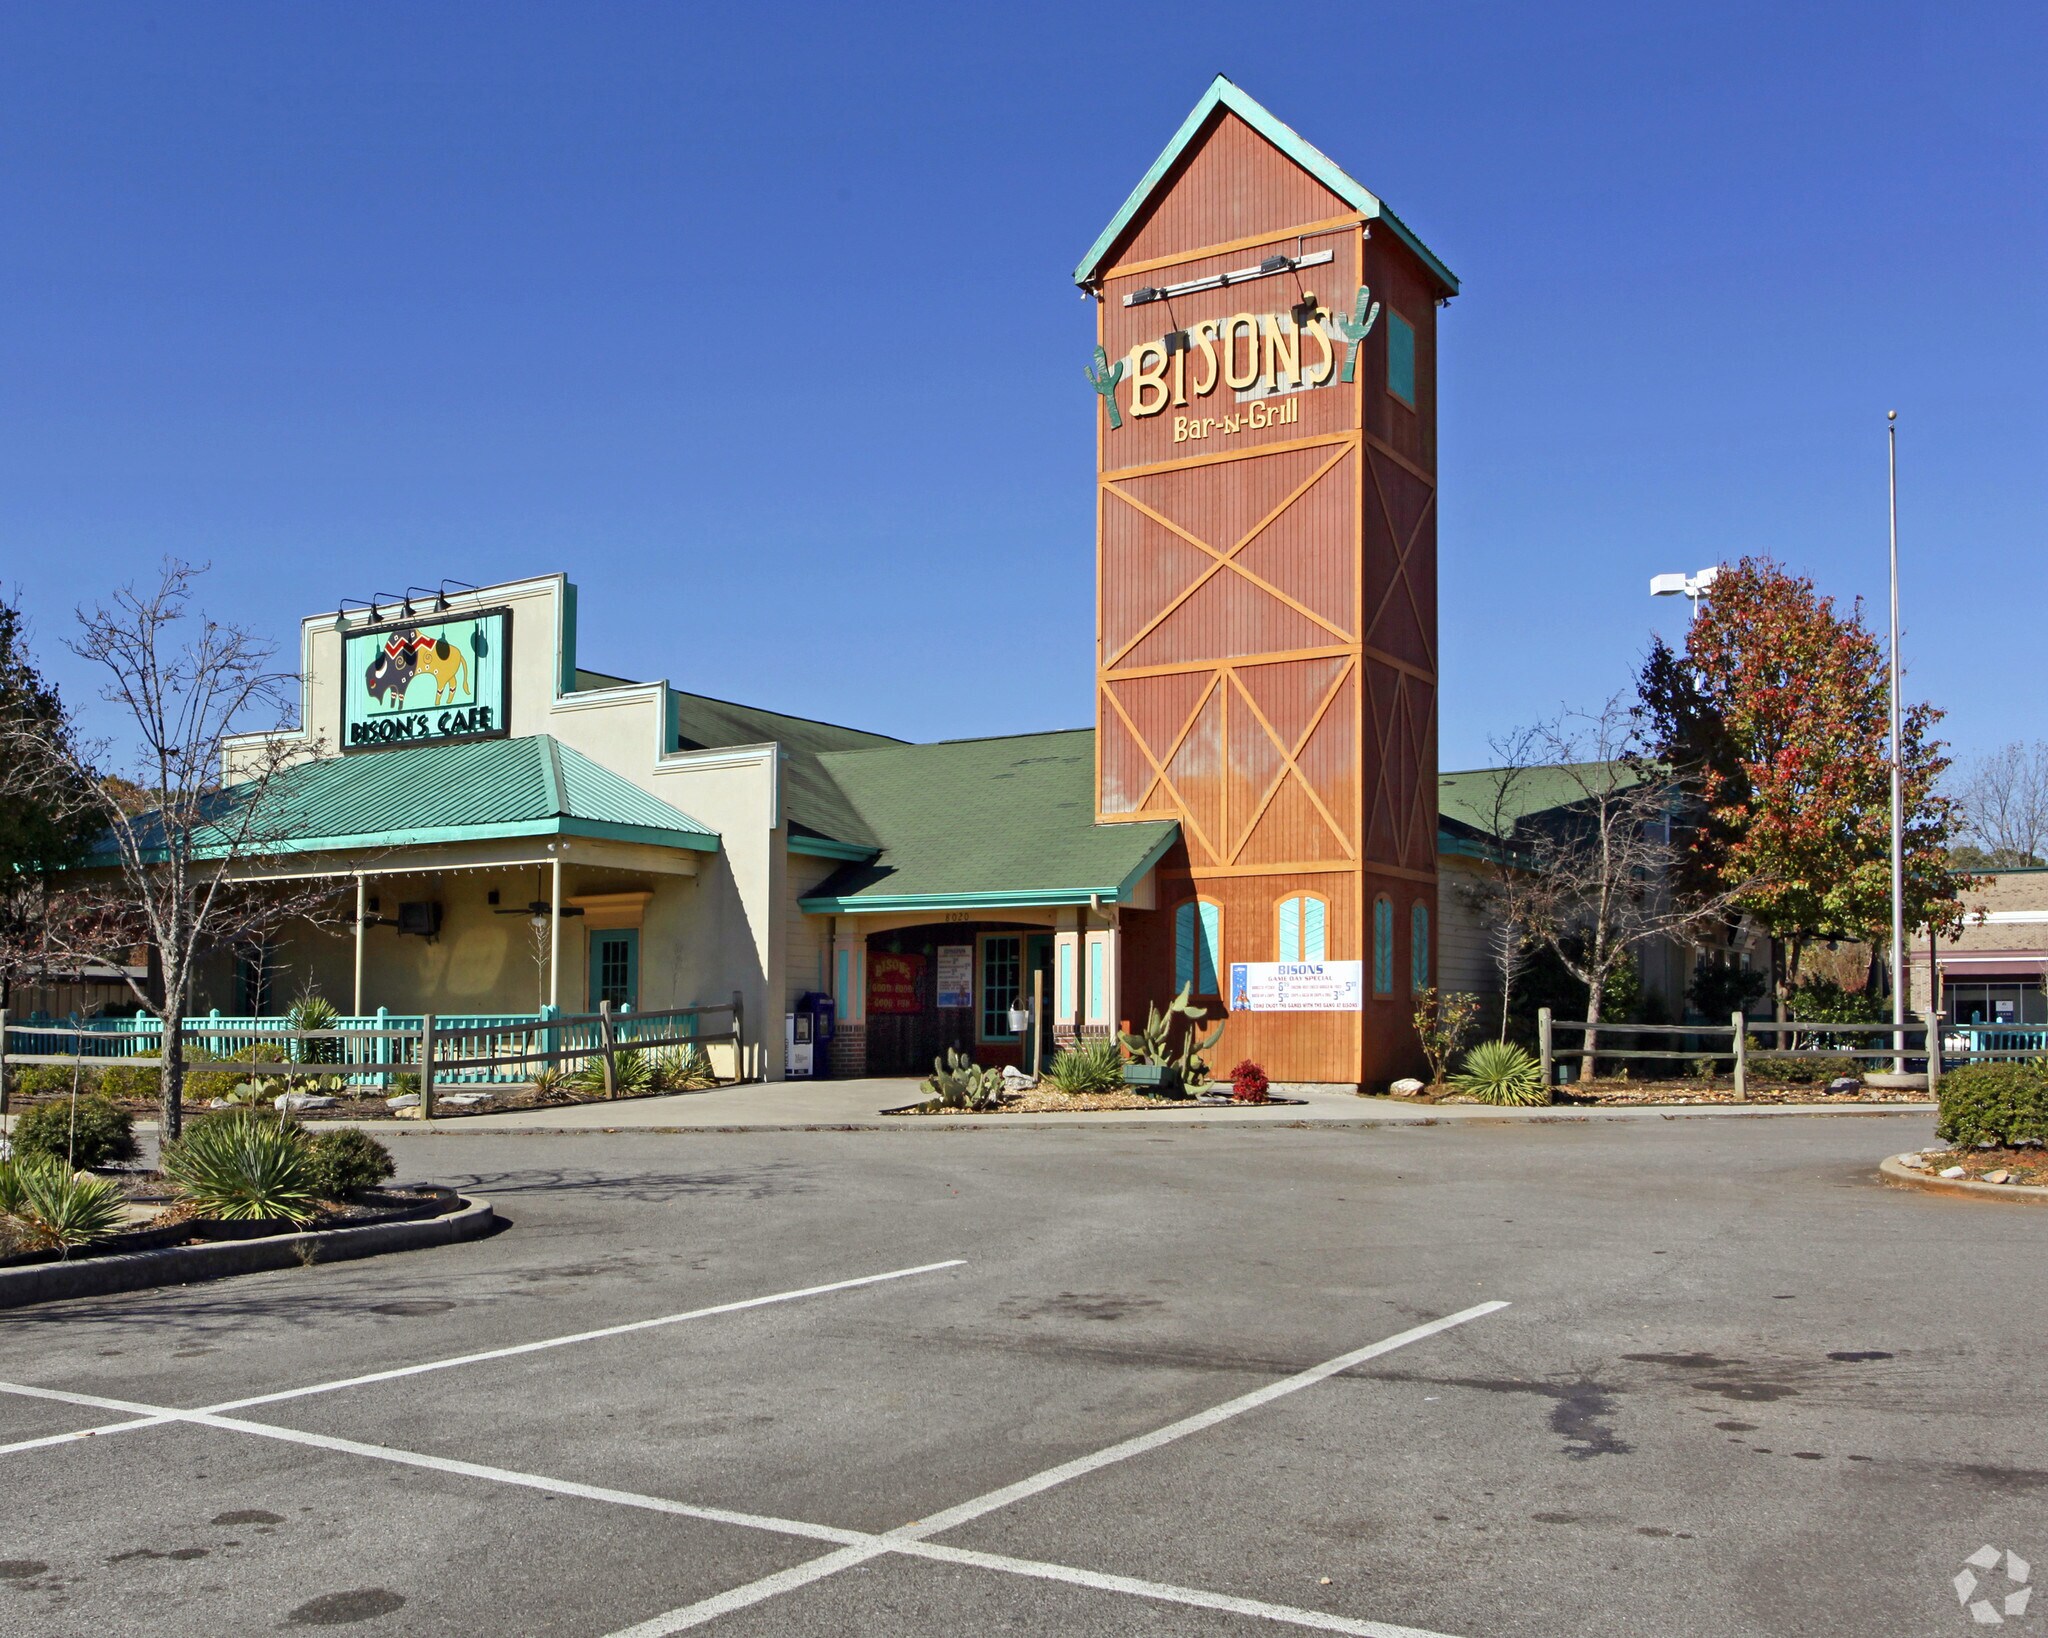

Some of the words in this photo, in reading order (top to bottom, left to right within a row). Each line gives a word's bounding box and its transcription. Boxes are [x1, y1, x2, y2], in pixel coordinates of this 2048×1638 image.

[1129, 306, 1335, 418] BISONS
[1173, 398, 1299, 443] Bar-N-Grill
[351, 714, 429, 743] BISON'S
[437, 706, 493, 732] CAFE
[945, 912, 969, 921] 8020
[875, 958, 911, 980] BISONS
[1278, 964, 1323, 975] BISONS
